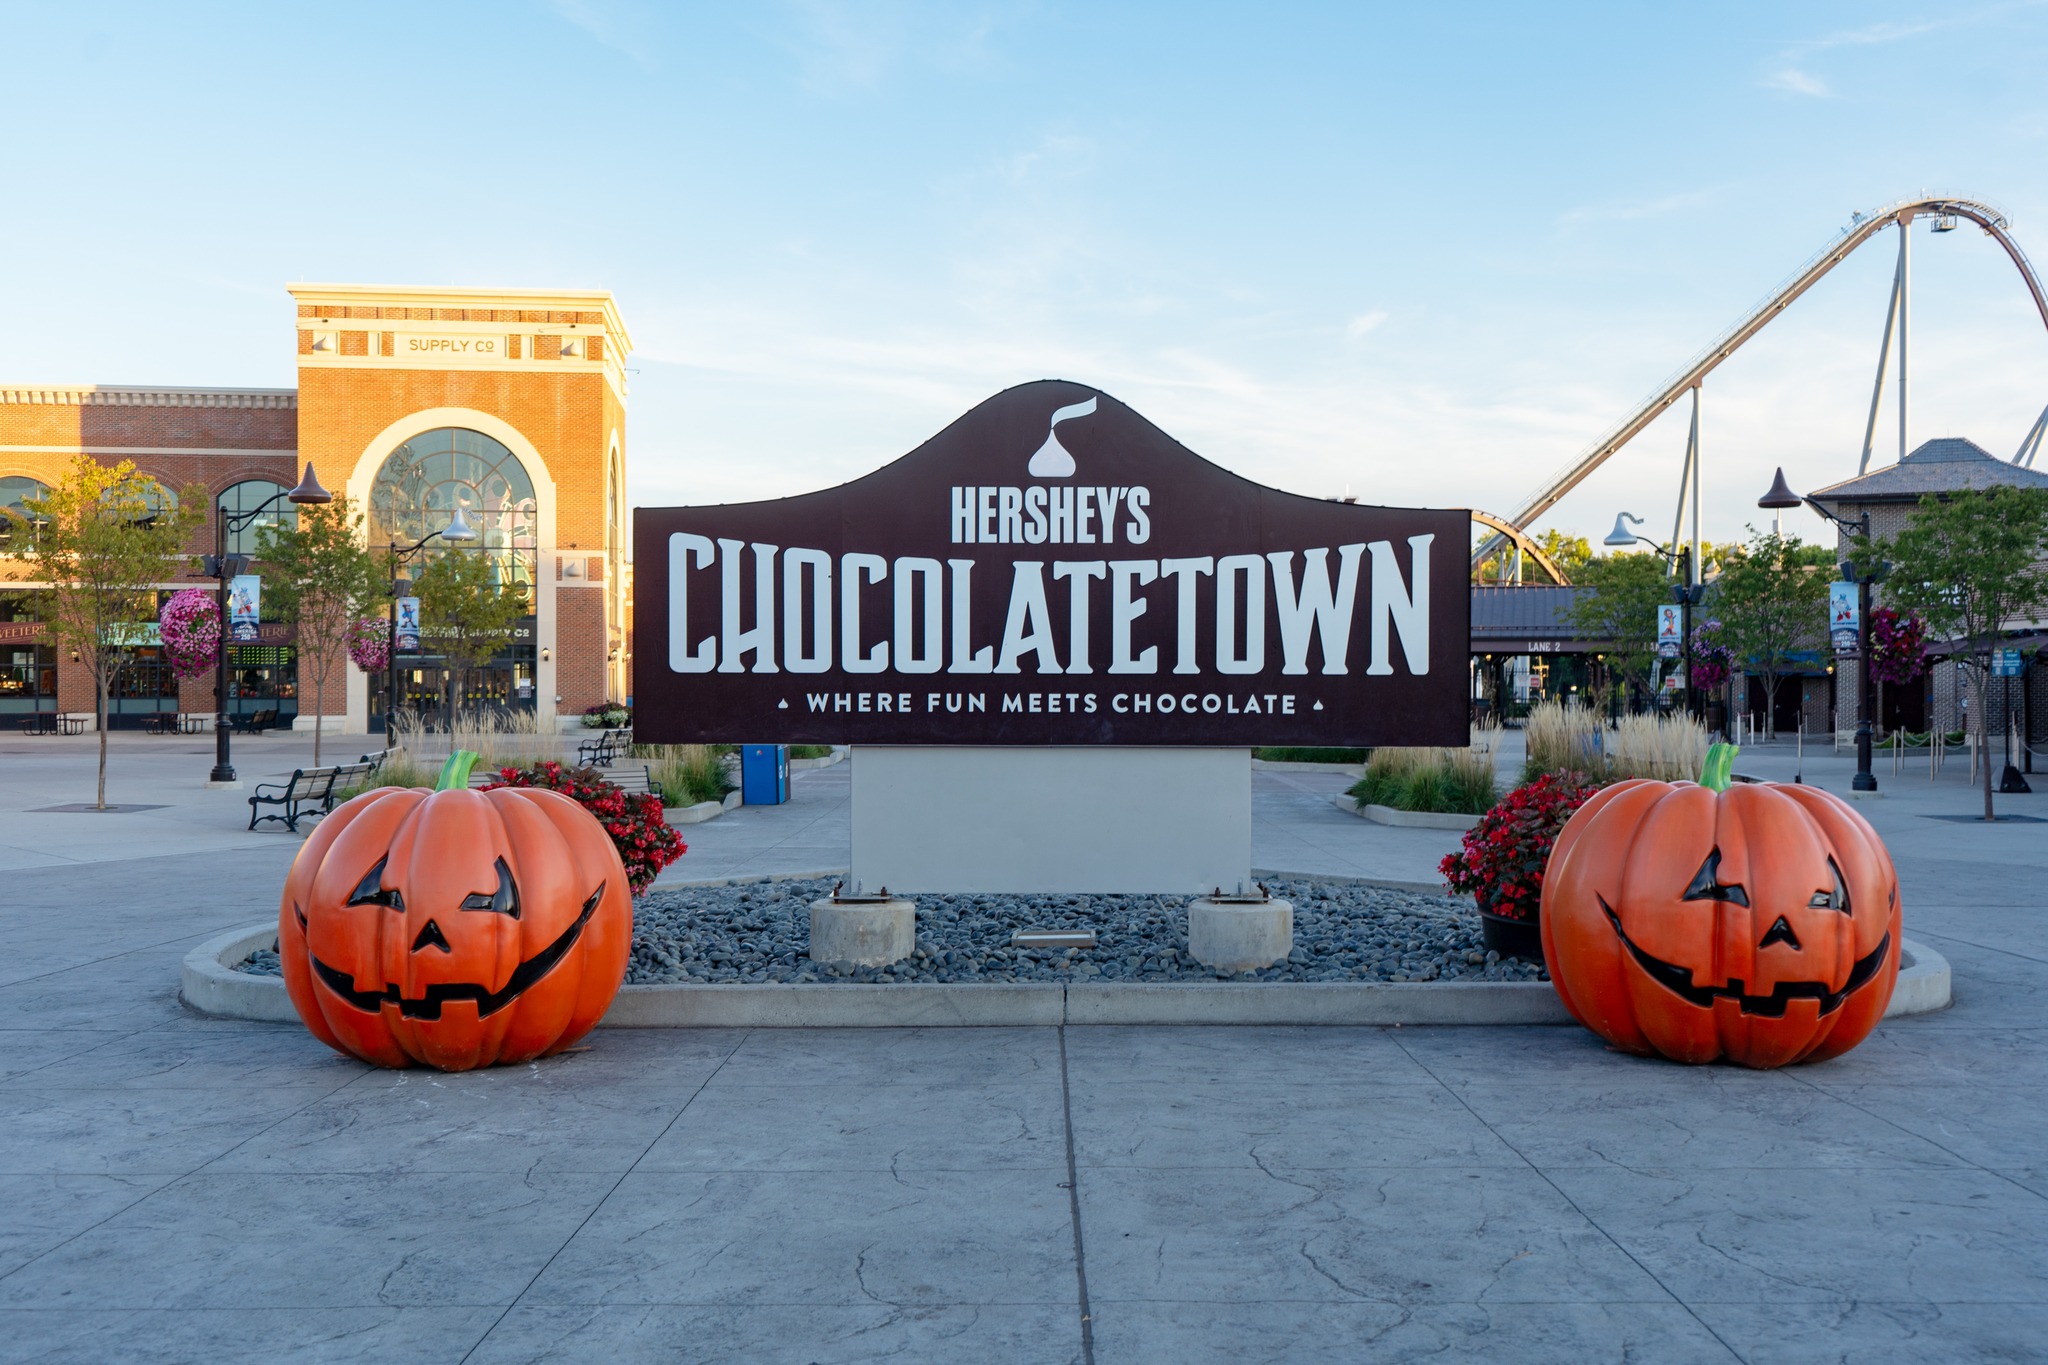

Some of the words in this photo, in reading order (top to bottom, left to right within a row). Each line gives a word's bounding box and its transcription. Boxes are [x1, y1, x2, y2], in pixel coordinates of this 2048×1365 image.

[409, 338, 470, 352] SUPPLY
[951, 485, 1151, 545] HERSHEY'S
[669, 532, 1436, 676] CHOCOLATETOWN
[1528, 642, 1551, 652] LANE
[1554, 642, 1561, 652] 2
[806, 693, 912, 713] WHERE
[928, 693, 985, 713] FUN
[1002, 693, 1097, 713] MEETS
[1112, 693, 1296, 714] CHOCOLATE
